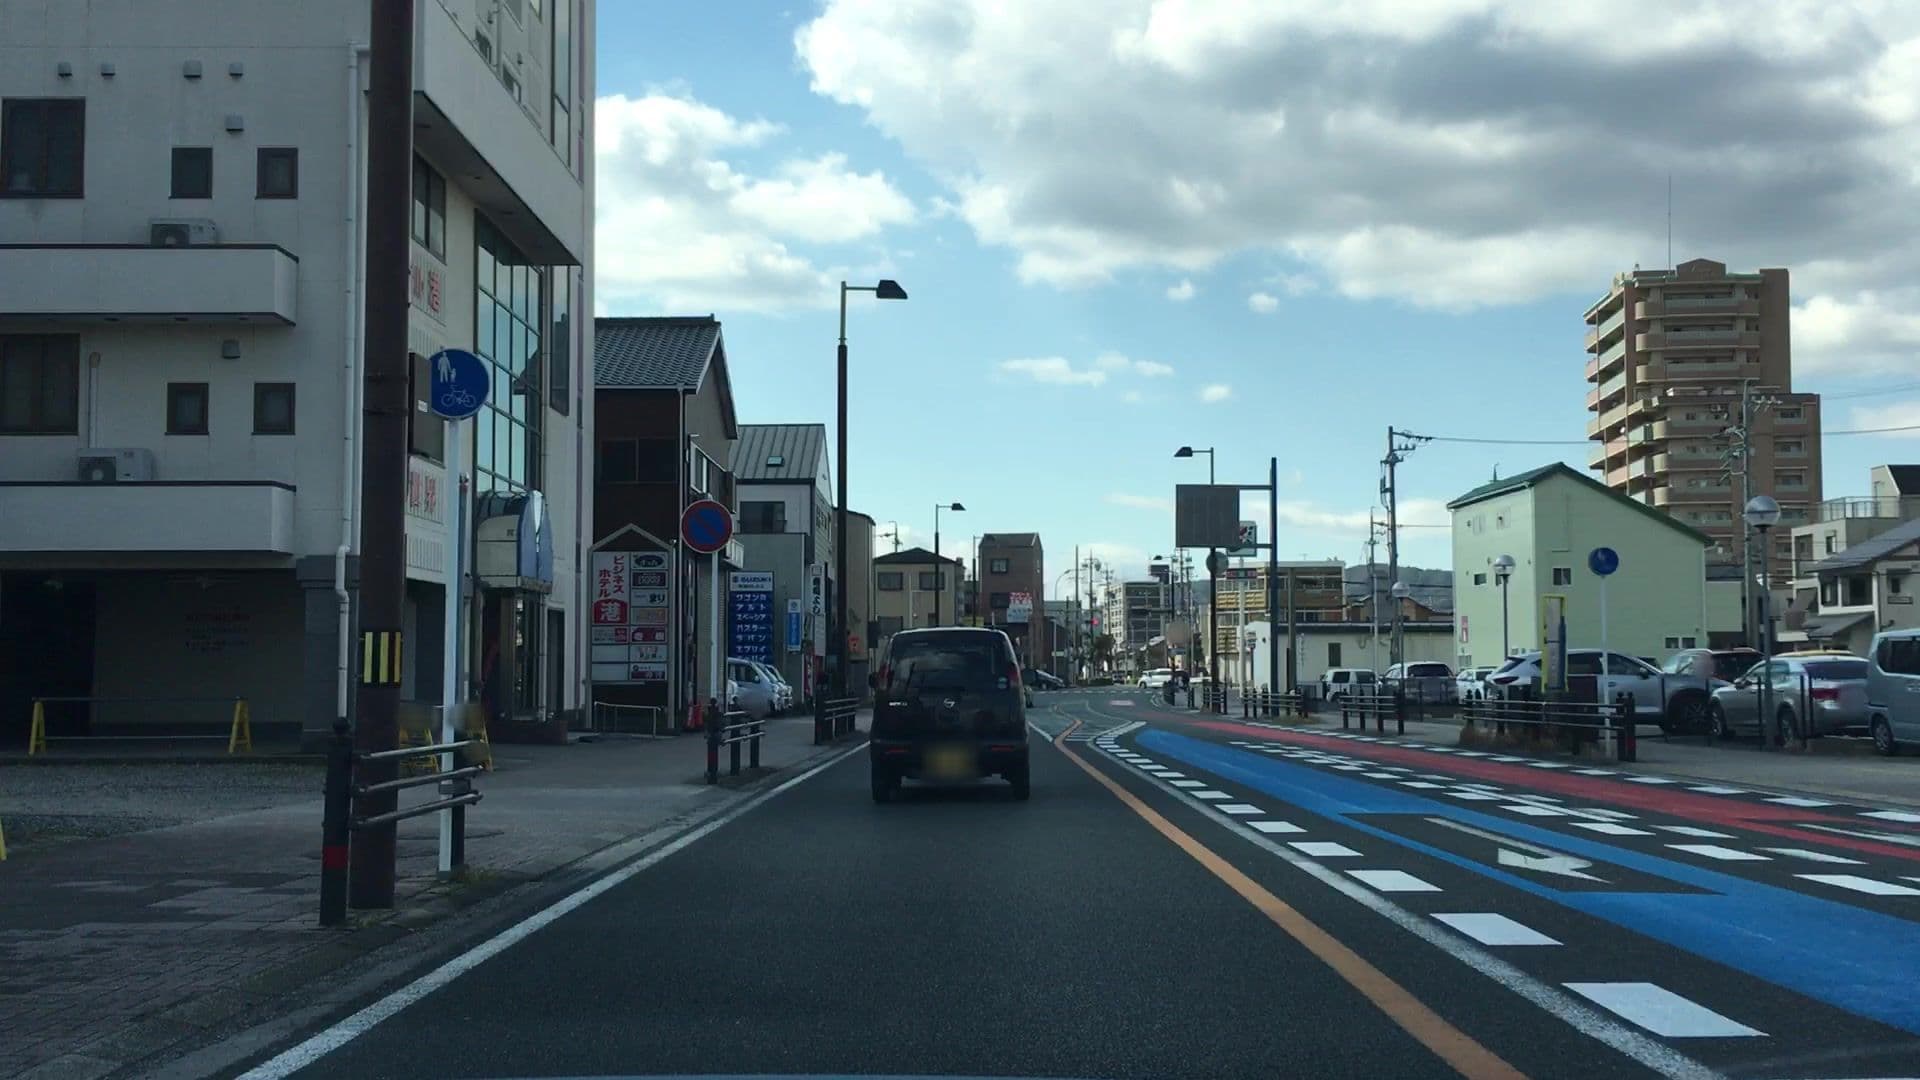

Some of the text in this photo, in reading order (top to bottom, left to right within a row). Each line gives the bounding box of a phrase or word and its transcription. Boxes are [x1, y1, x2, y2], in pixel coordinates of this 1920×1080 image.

[598, 568, 611, 598] ホテル
[613, 554, 625, 594] ビジネス
[600, 602, 620, 622] 港
